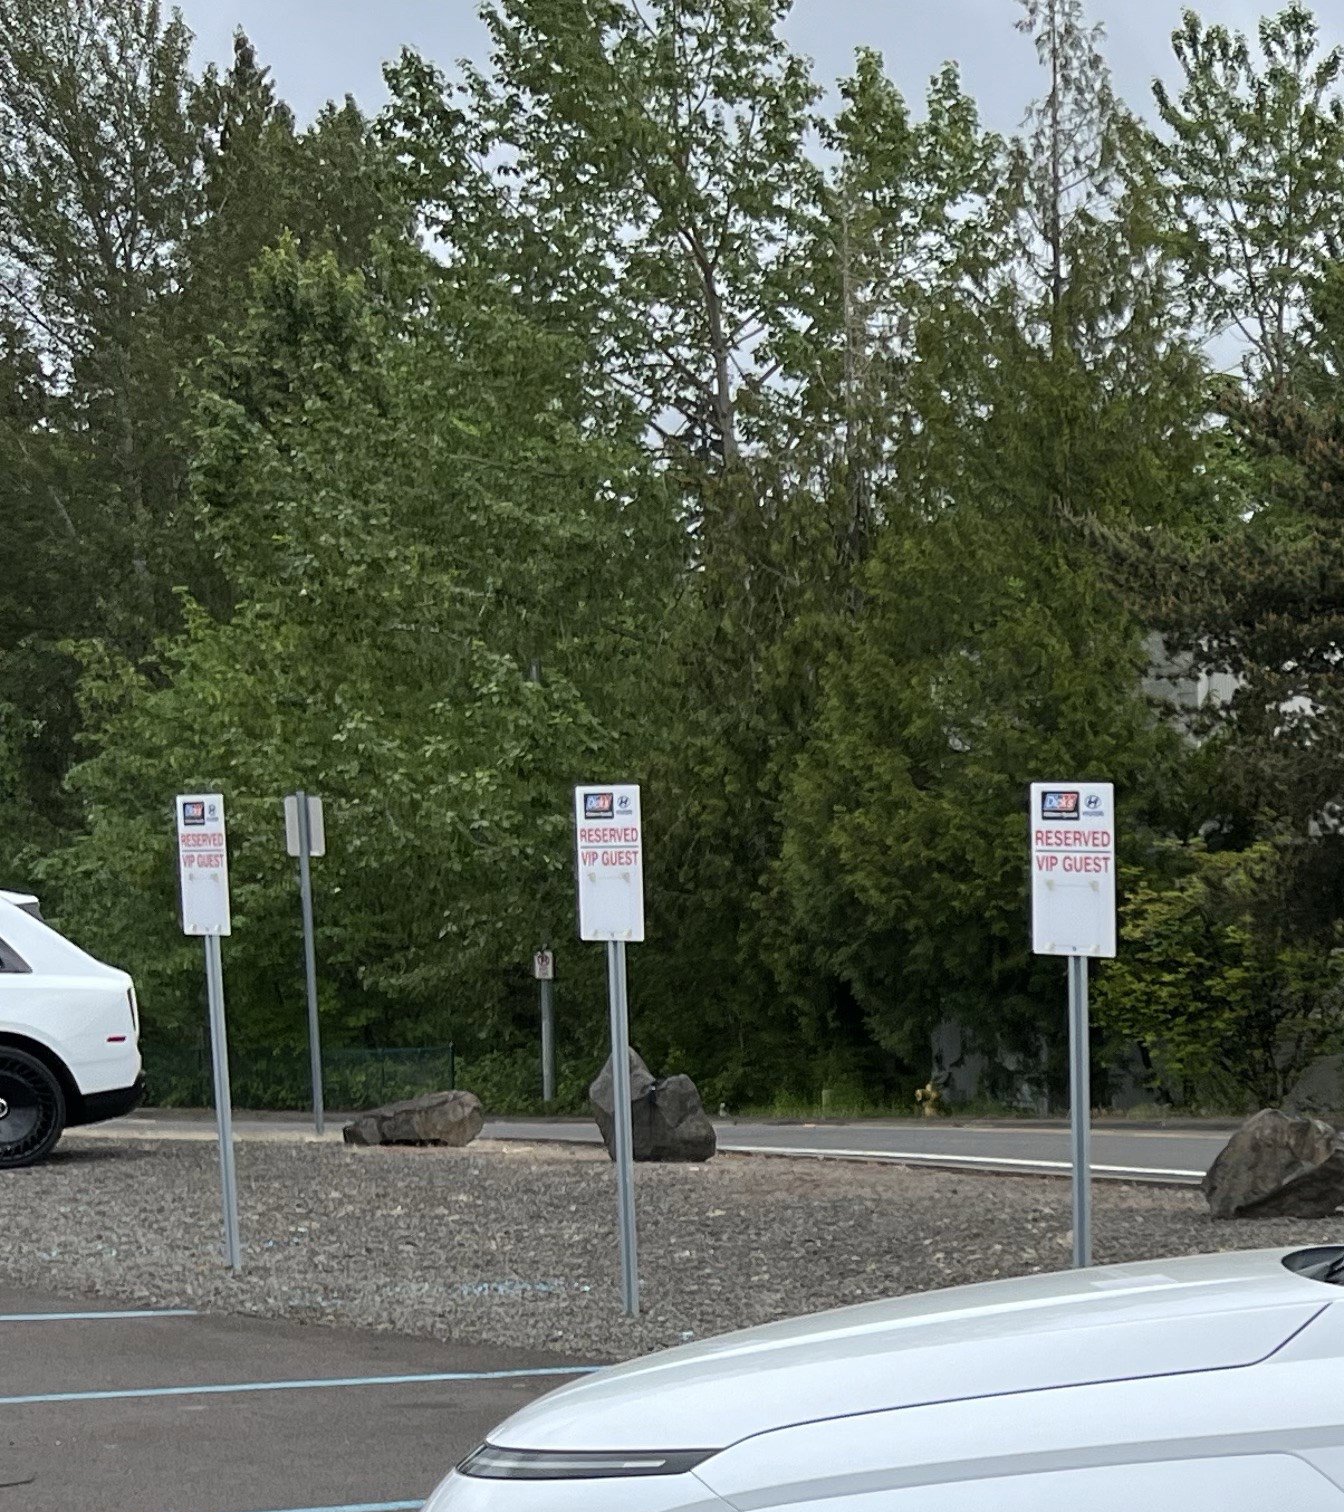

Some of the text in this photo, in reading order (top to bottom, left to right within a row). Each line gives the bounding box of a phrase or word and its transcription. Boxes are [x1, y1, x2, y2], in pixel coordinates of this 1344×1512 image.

[181, 833, 223, 847] RESERVED
[580, 827, 639, 844] RESERVED
[1035, 830, 1111, 848] RESERVED
[181, 854, 224, 868] VIP GUEST
[581, 850, 639, 867] VIP GUEST
[1036, 855, 1111, 873] VIP GUEST
